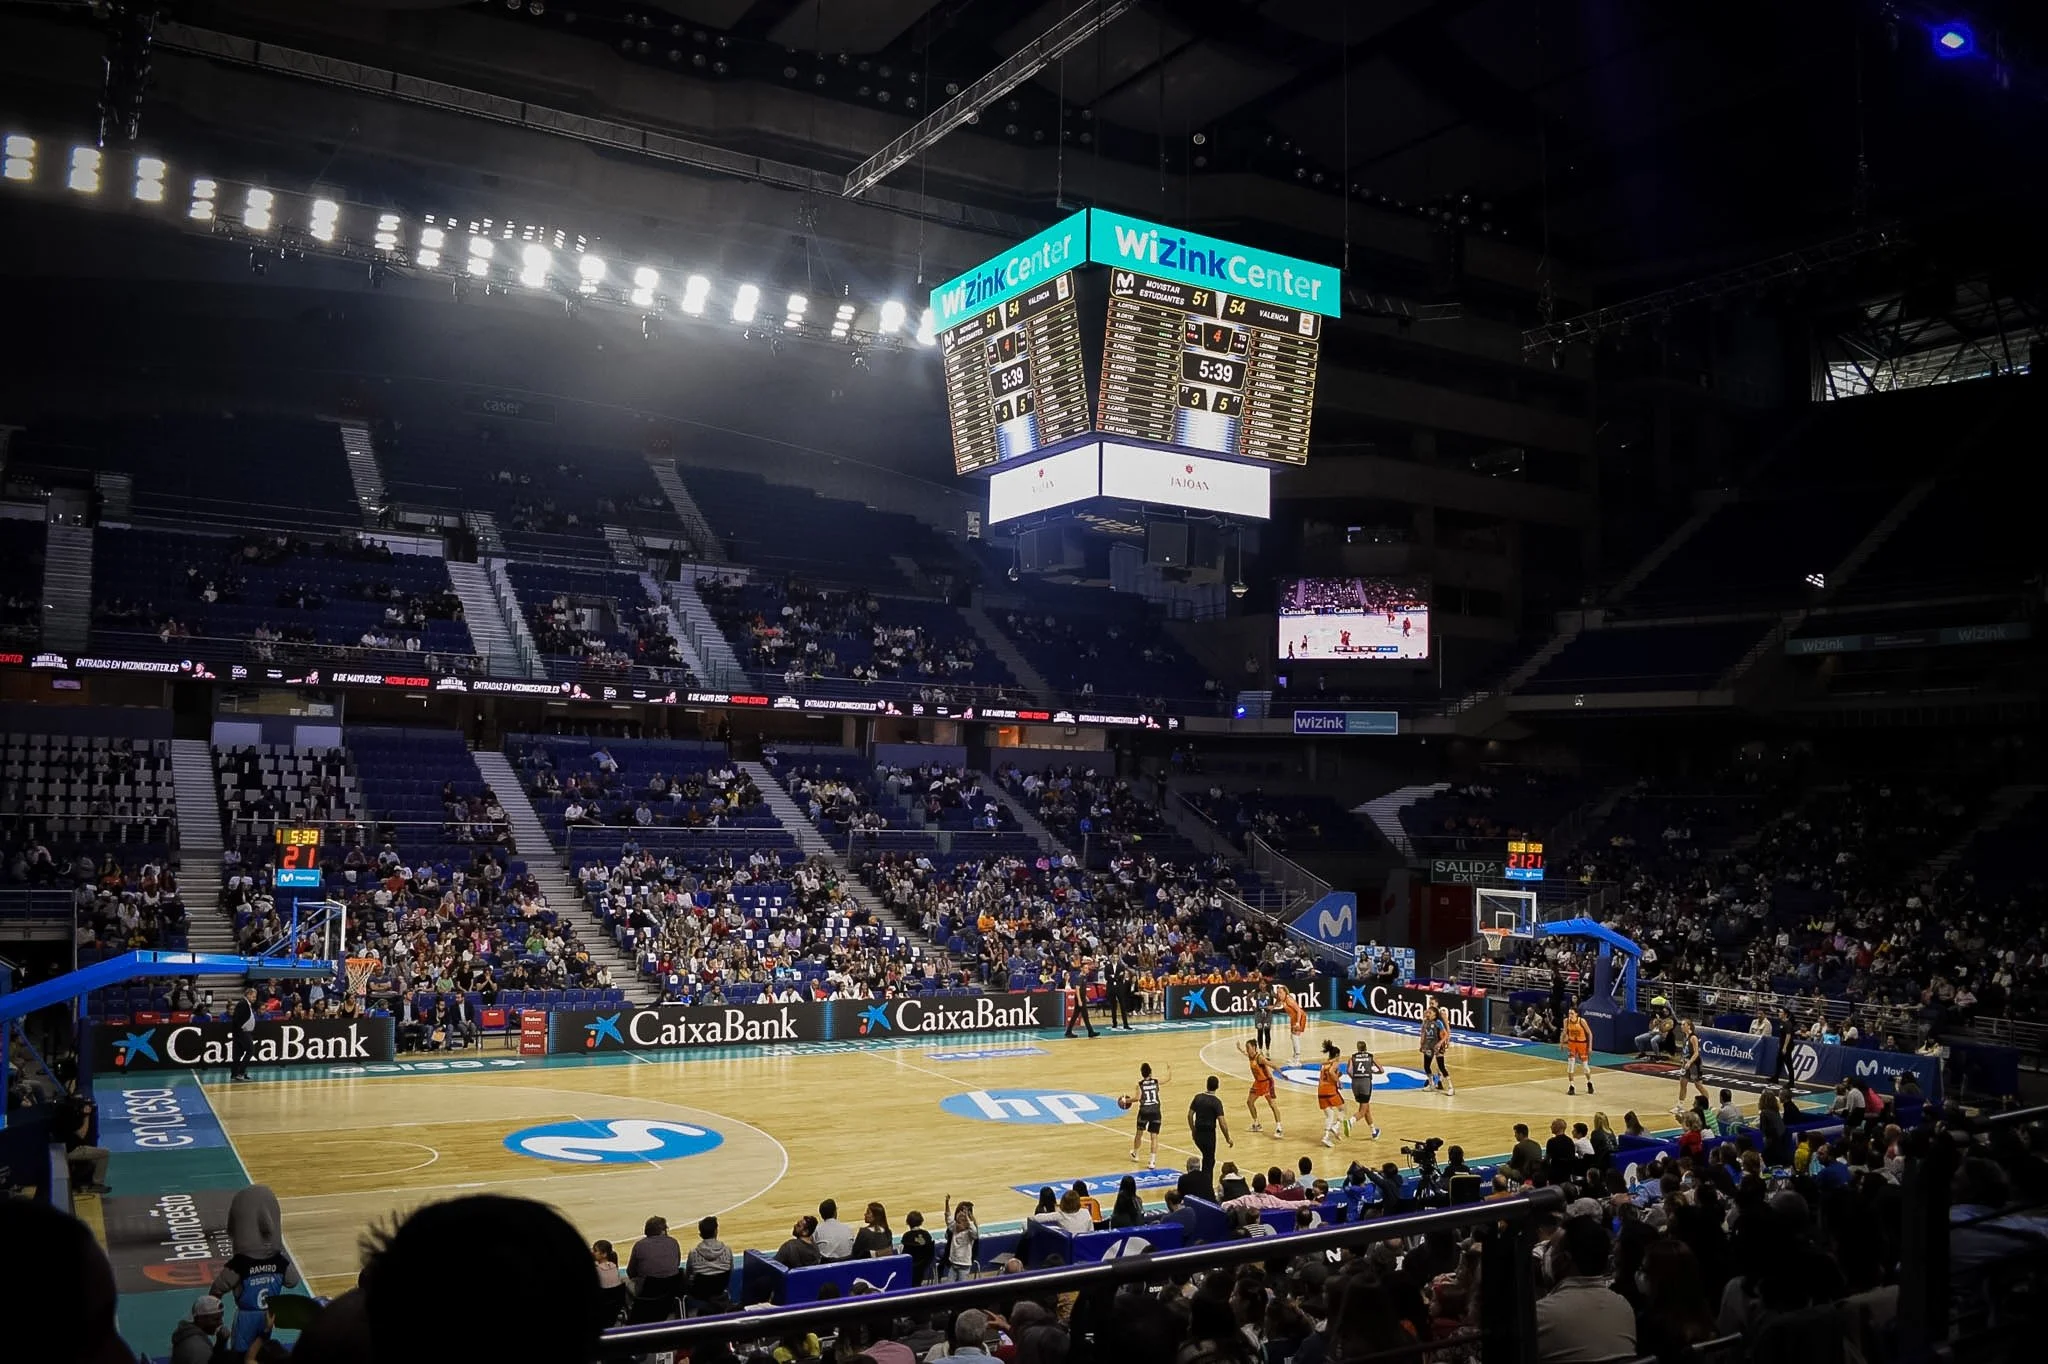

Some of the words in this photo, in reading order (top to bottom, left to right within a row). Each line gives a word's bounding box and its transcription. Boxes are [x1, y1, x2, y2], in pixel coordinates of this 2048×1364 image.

[1115, 225, 1322, 301] WiZinkCenter
[1146, 280, 1181, 293] MOVISTAR
[1139, 289, 1185, 305] ESTUDIANTES
[1192, 291, 1209, 307] 51
[1008, 301, 1020, 318] 54
[1229, 299, 1246, 315] 54
[986, 312, 996, 328] 51
[1259, 310, 1289, 322] VALENCIA
[1213, 329, 1222, 342] 4
[1004, 339, 1010, 351] 4
[1199, 360, 1233, 382] 5:39
[1001, 367, 1023, 391] 5:39
[1191, 392, 1200, 405] 3
[1219, 398, 1229, 411] 5
[1020, 399, 1026, 412] 5
[1002, 406, 1008, 419] 3
[75, 658, 111, 669] ENTRADAS
[111, 660, 121, 669] EN
[338, 673, 347, 682] DE
[365, 675, 382, 684] 2022
[1297, 716, 1344, 729] WiZink
[290, 830, 319, 845] 5:39
[283, 846, 316, 870] 21
[1435, 861, 1498, 874] SALIDA
[1452, 873, 1481, 882] EXIT
[895, 995, 1041, 1034] CaixaBank
[629, 1006, 799, 1046] CaixaBank
[1701, 1039, 1755, 1061] CaixaBank
[1357, 1062, 1366, 1074] 4
[1144, 1089, 1158, 1103] 11
[122, 1088, 194, 1147] endesa
[249, 1264, 277, 1276] RAMIRO
